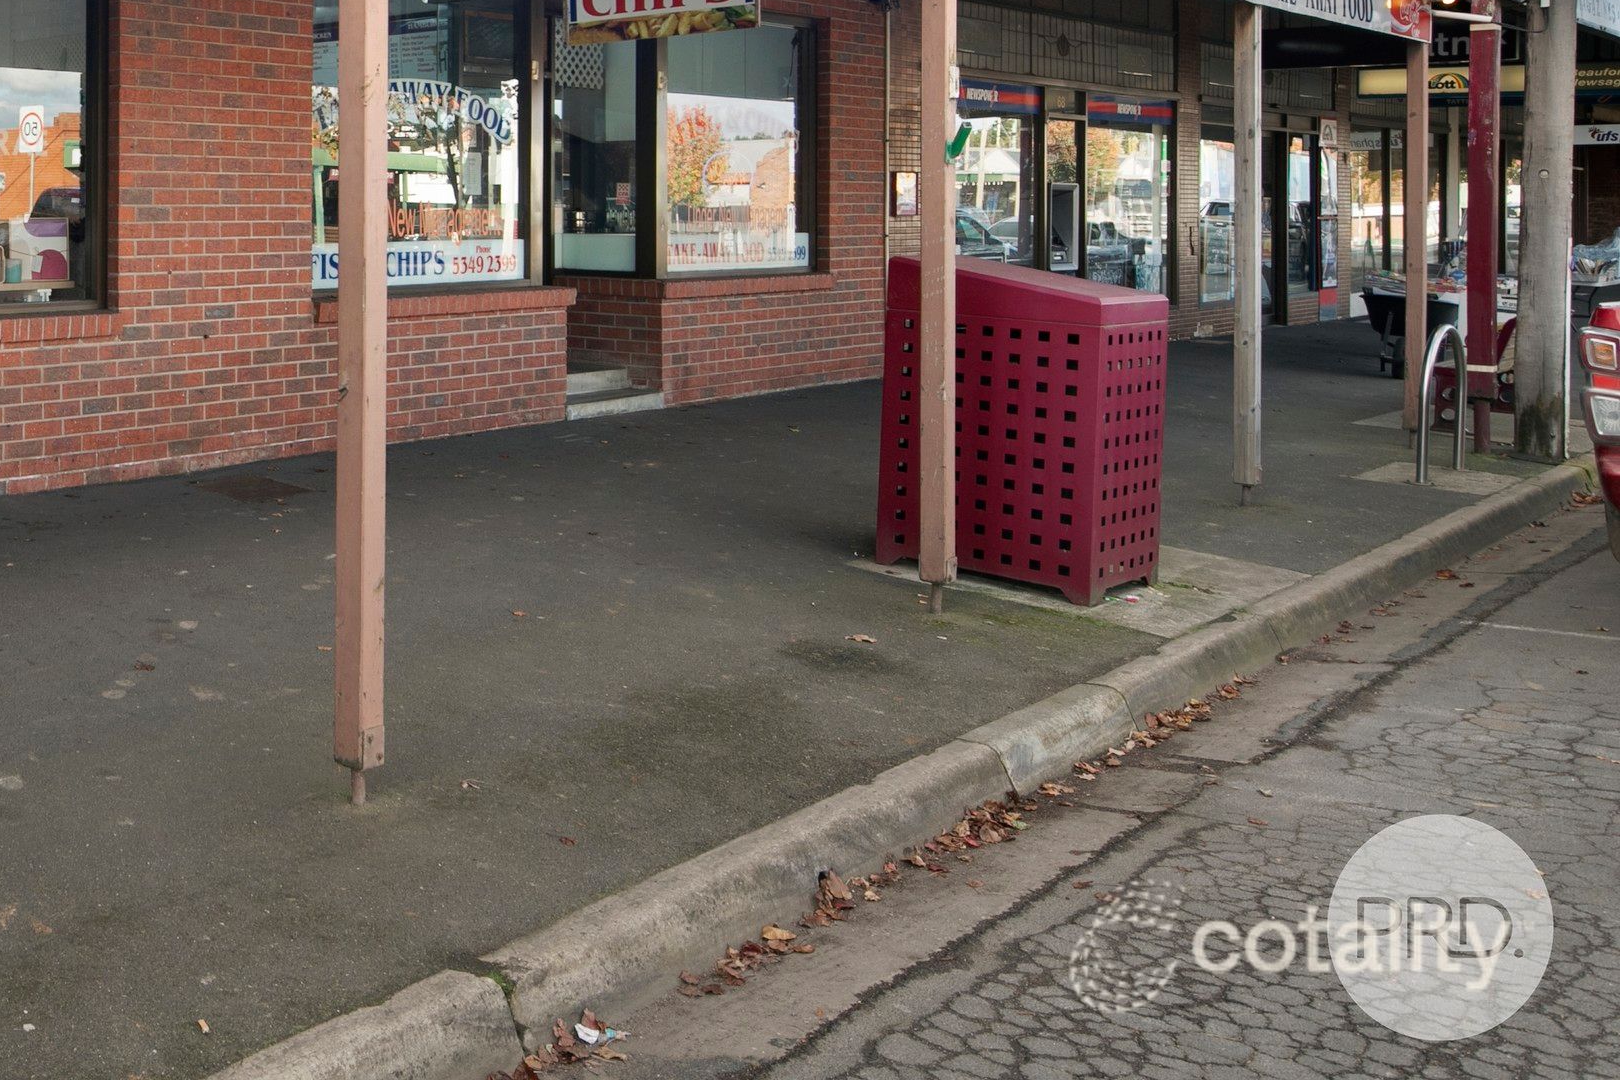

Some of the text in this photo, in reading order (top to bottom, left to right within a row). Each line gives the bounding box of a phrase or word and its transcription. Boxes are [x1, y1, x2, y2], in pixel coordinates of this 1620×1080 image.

[455, 87, 511, 142] FOOD
[386, 250, 446, 278] CHIPS
[452, 254, 517, 275] 5349 2399
